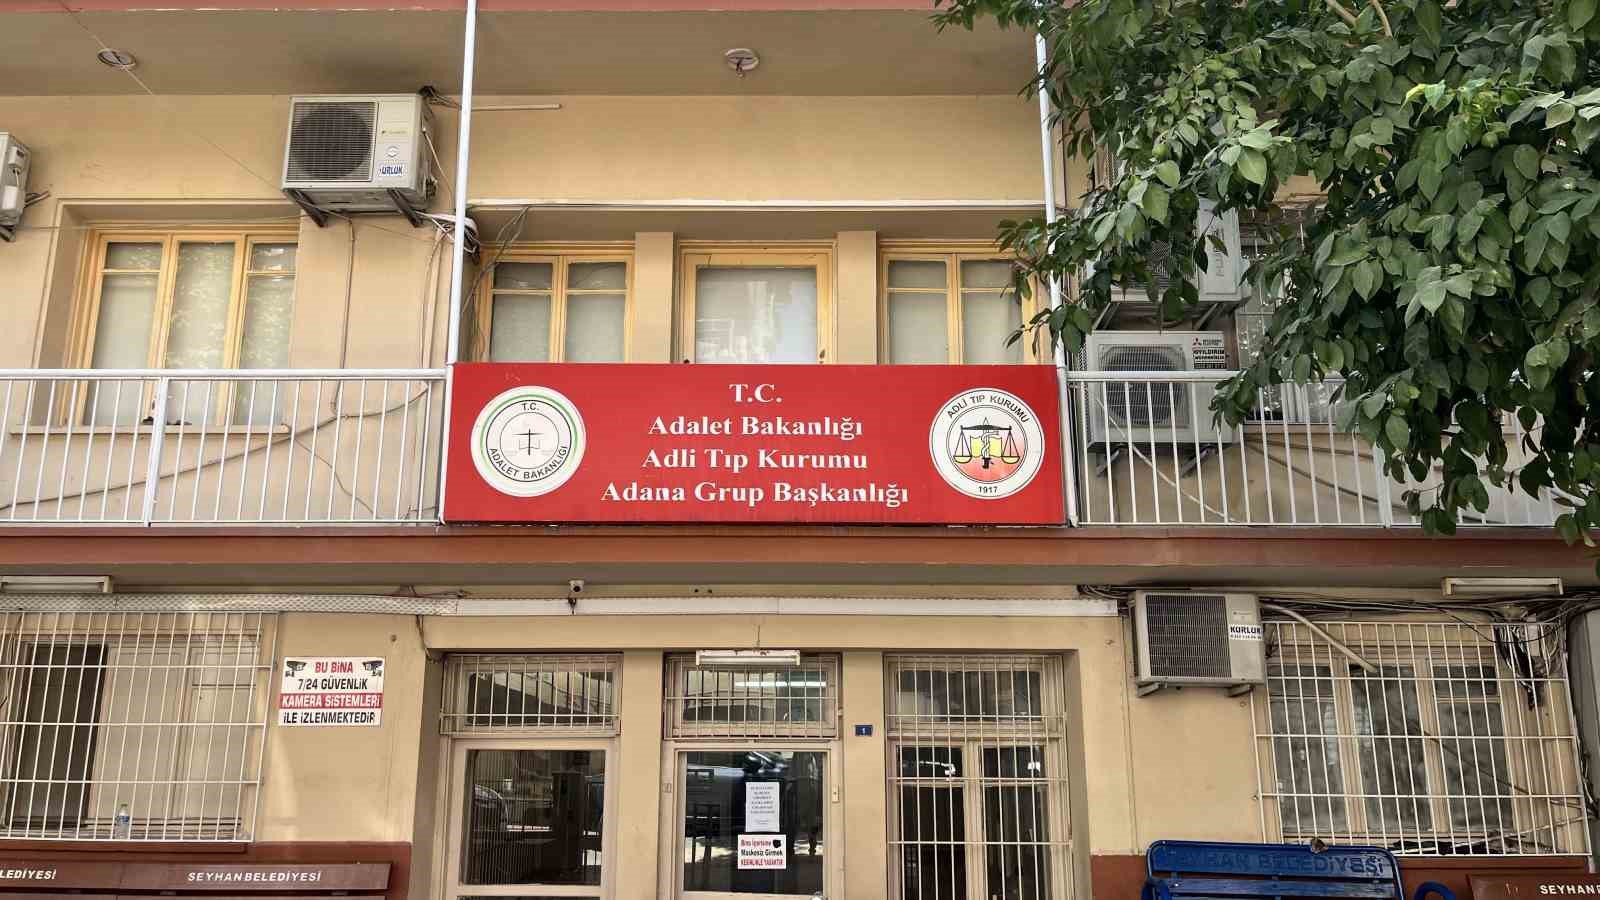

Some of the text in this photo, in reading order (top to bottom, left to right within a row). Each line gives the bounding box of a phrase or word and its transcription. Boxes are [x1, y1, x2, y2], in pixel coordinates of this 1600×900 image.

[729, 383, 782, 403] T.C.
[521, 402, 540, 411] T.C.
[990, 394, 1031, 423] KURUMU
[648, 416, 863, 441] Adalet Bakanlığı
[489, 447, 519, 477] ADALET
[641, 448, 868, 474] Adli Tıp Kurumu
[600, 481, 909, 508] Adana Grup Başkanlığı
[978, 486, 998, 494] 1917
[315, 661, 353, 673] BU BİNA
[297, 675, 368, 691] 7/24 GÜVENLİK
[282, 694, 380, 707] KAMERA SİSTEMLERİ
[283, 711, 298, 724] İLE
